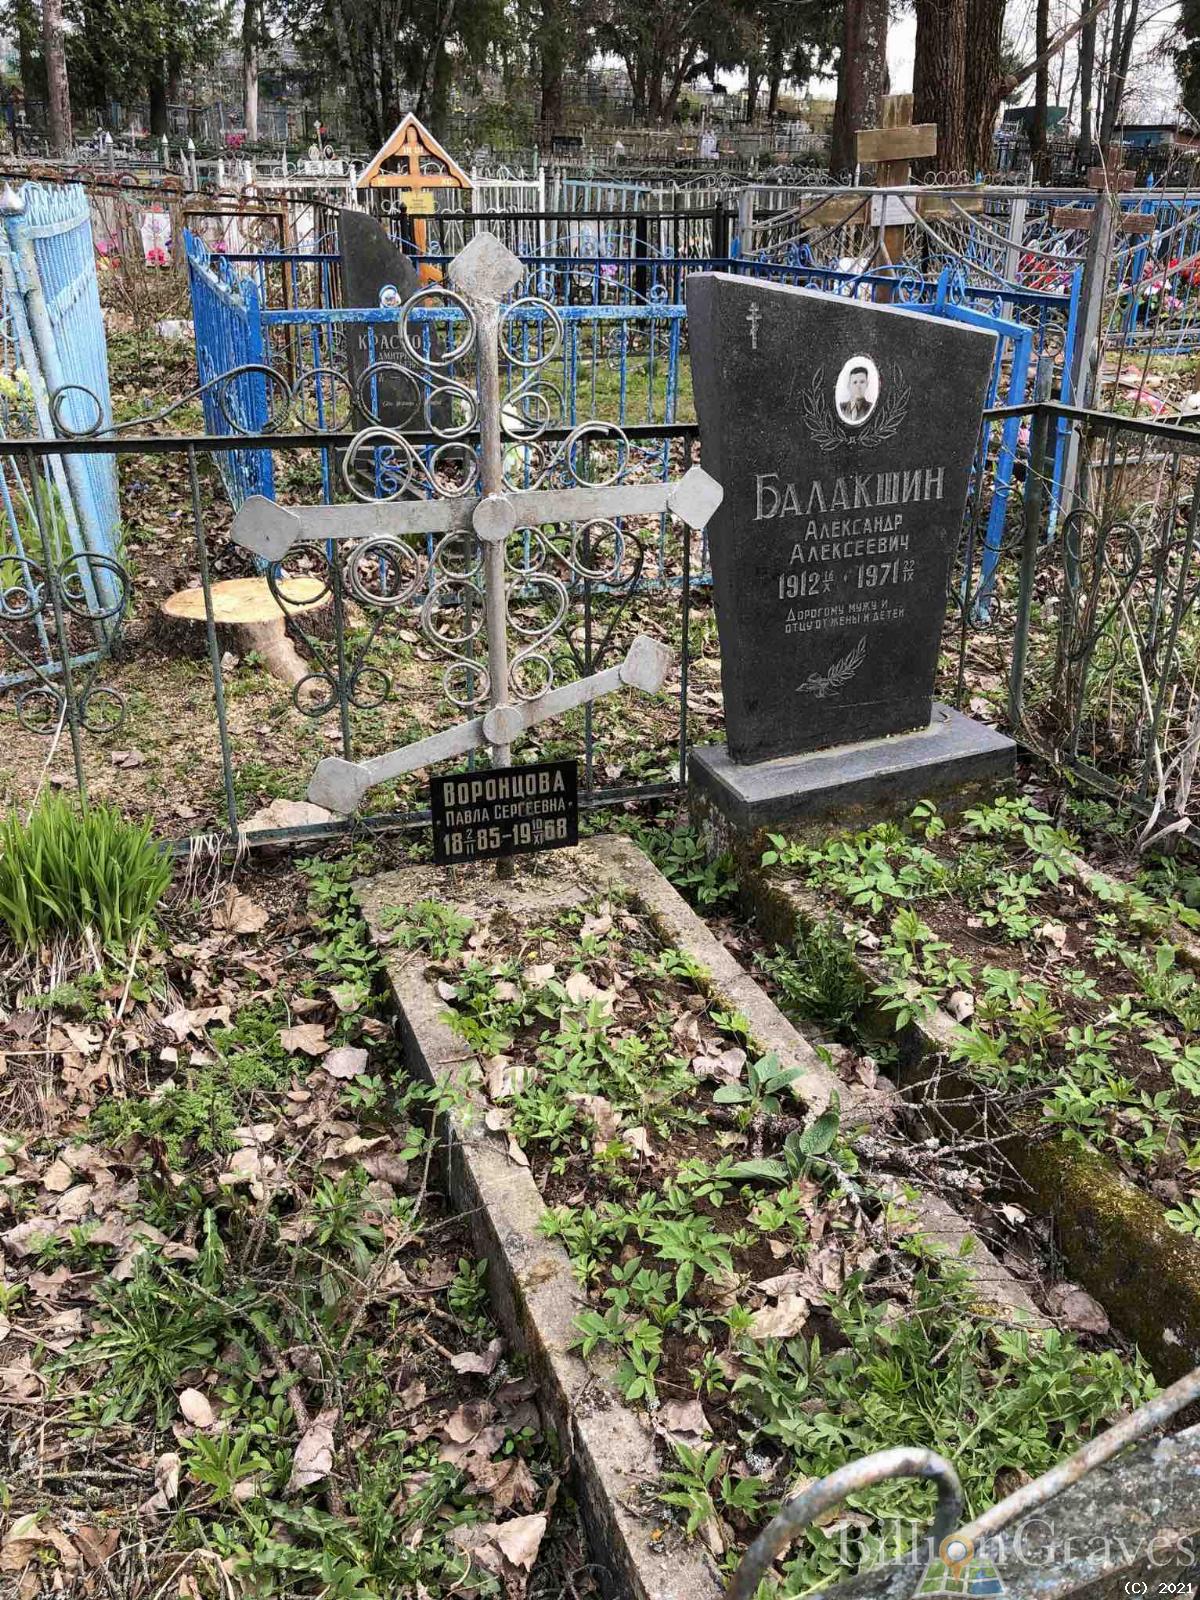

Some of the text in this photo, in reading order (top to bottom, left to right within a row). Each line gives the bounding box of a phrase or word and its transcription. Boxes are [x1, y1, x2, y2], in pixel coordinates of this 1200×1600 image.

[752, 466, 946, 521] БАЛАКШИН
[804, 513, 904, 541] АЛЕКСАНДР
[789, 534, 910, 565] АЛЕКСЕЕВИЧ
[778, 570, 820, 600] 1912
[857, 559, 900, 589] 1971
[785, 604, 845, 622] ДОРОГОМУ
[849, 600, 877, 613] МУЖУ
[443, 770, 565, 807] ВОРОНЦОВА
[446, 797, 566, 827] ПАВЛА СЕРГЕЕВНА
